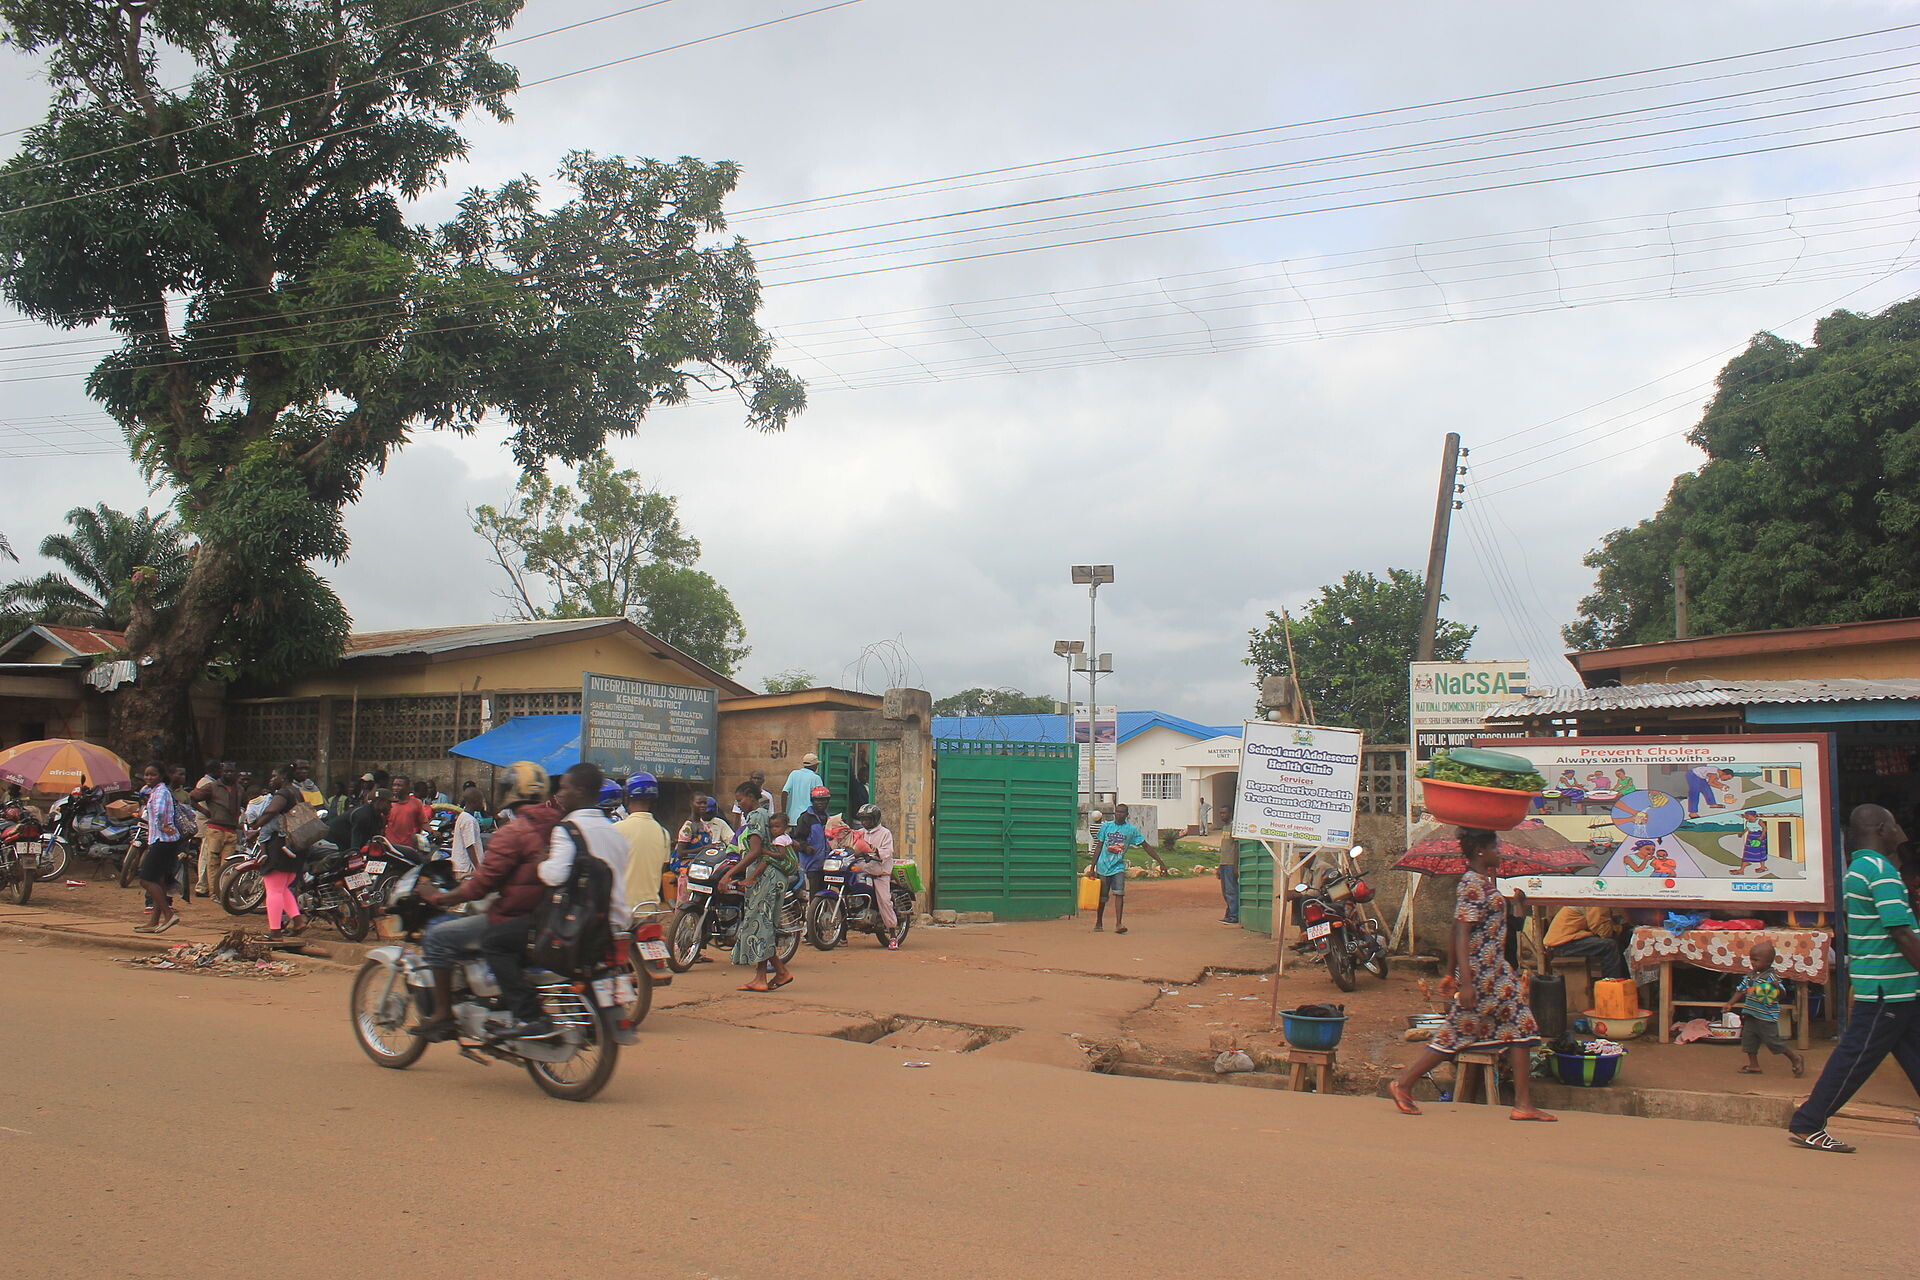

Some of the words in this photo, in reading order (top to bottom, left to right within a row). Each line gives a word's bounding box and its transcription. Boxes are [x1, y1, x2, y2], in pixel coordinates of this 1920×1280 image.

[591, 677, 641, 695] INTEGRATED
[644, 683, 667, 698] CHILD
[669, 686, 709, 703] SURVIVAL
[1434, 672, 1509, 695] NaCSA
[616, 694, 651, 707] KENEMA
[652, 699, 682, 710] DISTRICT
[1415, 702, 1441, 712] NATIONAL
[1442, 702, 1474, 712] COMMISSION
[1475, 702, 1486, 712] FOR
[1452, 717, 1475, 725] GOVERNMENT
[616, 729, 624, 740] BY
[1419, 733, 1447, 746] PUBLIC
[770, 739, 788, 759] 50
[1248, 743, 1283, 757] School
[1282, 748, 1303, 760] and
[1302, 748, 1358, 765] Adolescent
[1580, 748, 1642, 757] Prevent
[1647, 747, 1710, 756] Cholera
[1556, 756, 1598, 765] Always
[1601, 756, 1632, 764] wash
[1635, 755, 1672, 764] hands
[1675, 755, 1703, 763] with
[1706, 756, 1736, 764] soap
[49, 769, 82, 777] africell
[1267, 758, 1302, 773] Health
[1302, 762, 1334, 776] Clinic
[1280, 775, 1314, 785] Services
[1246, 780, 1317, 797] Reproductive
[1317, 787, 1354, 801] Health
[1244, 792, 1299, 808] Treatment
[1298, 798, 1312, 809] of
[1311, 800, 1352, 813] Malaria
[1263, 807, 1321, 824] Counseling
[1293, 824, 1314, 832] services
[1732, 881, 1760, 891] unicef
